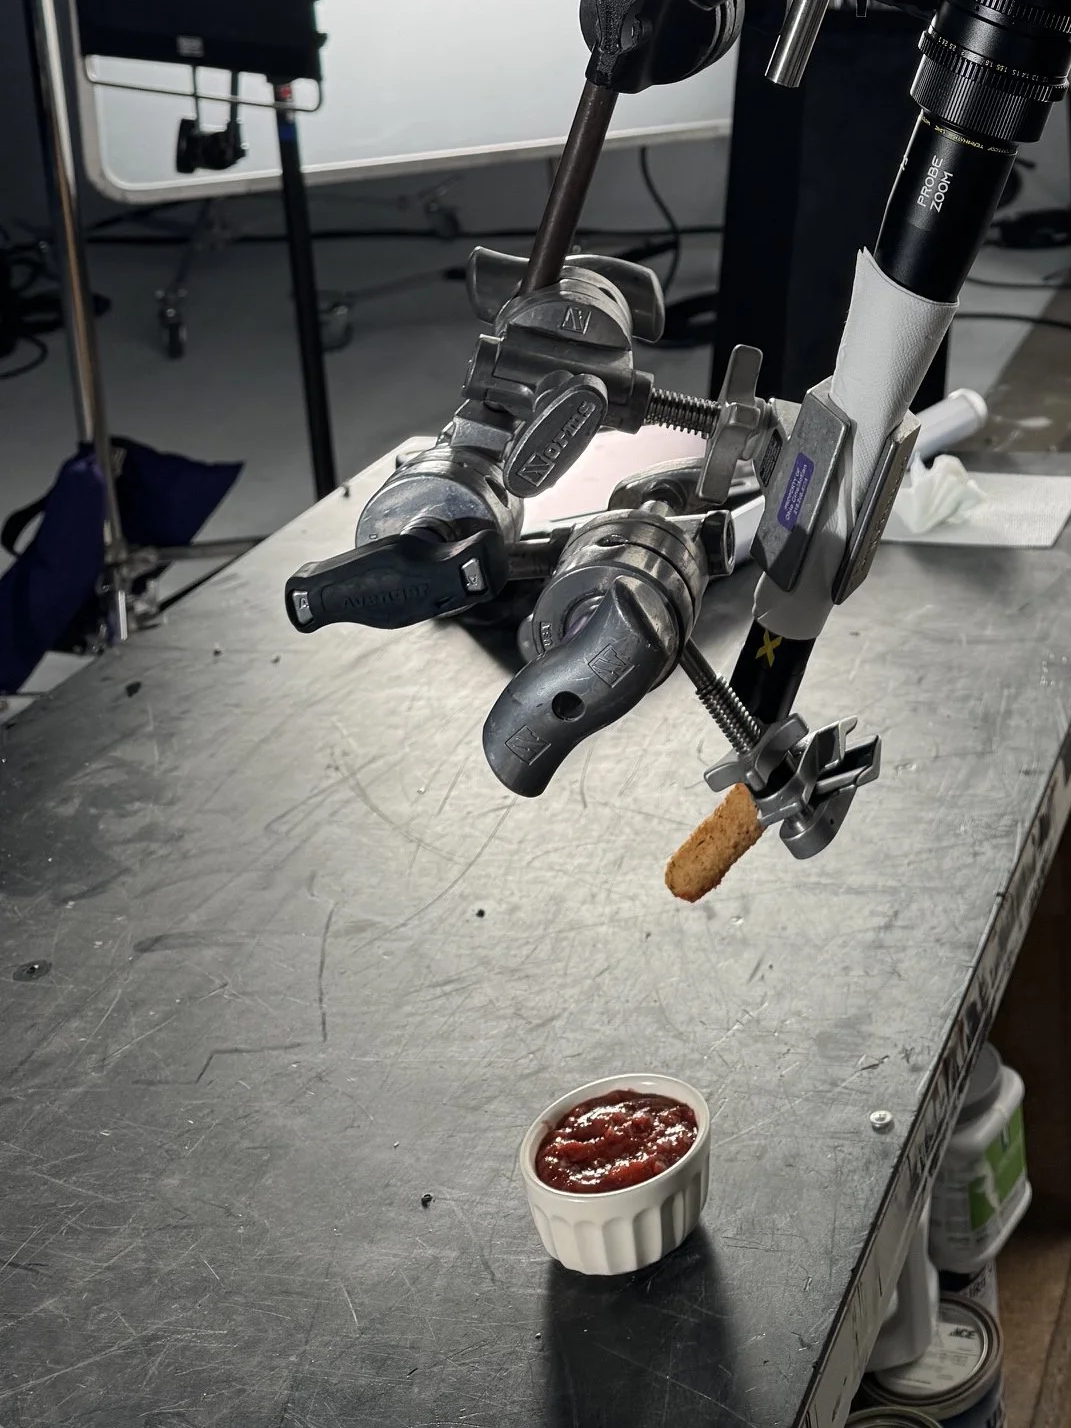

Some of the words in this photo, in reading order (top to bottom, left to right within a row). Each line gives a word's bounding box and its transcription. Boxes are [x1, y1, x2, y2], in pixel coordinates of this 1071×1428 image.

[916, 154, 944, 208] PROBE
[929, 170, 954, 213] ZOOM
[516, 397, 598, 488] Norms
[784, 503, 795, 521] Ohio
